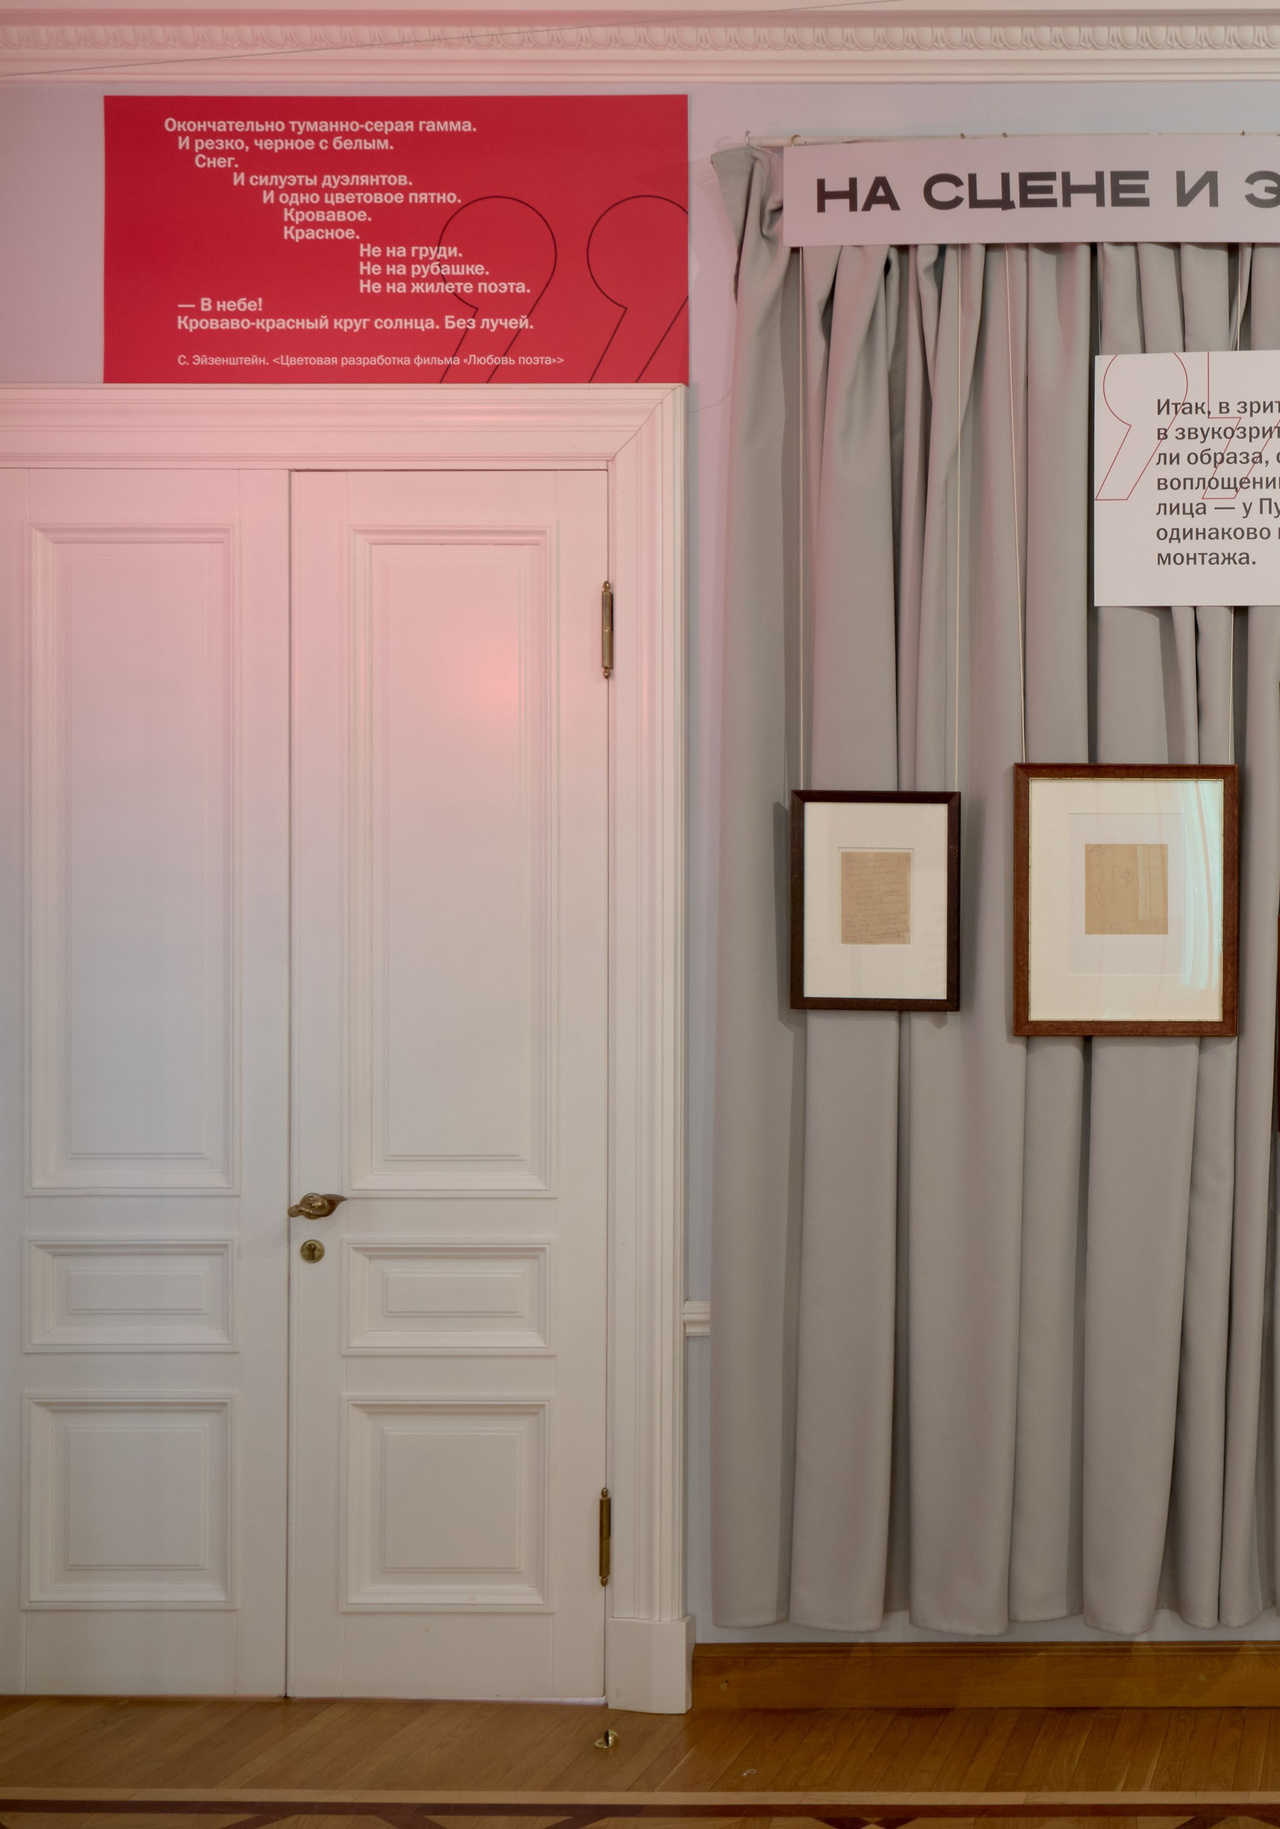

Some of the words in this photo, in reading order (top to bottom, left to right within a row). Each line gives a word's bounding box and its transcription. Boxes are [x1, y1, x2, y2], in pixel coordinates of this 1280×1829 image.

[164, 117, 286, 133] Окончательно
[288, 120, 415, 136] туманно-серая
[418, 120, 477, 133] гамма.
[177, 135, 190, 150] И
[194, 138, 250, 153] резко,
[253, 138, 316, 153] черное
[318, 138, 329, 151] с
[332, 135, 394, 151] белым.
[194, 153, 239, 169] Снег.
[233, 171, 245, 187] И
[248, 174, 318, 190] силуэты
[321, 174, 413, 189] дуэлянтов.
[262, 189, 275, 204] И
[278, 192, 320, 207] одно
[324, 192, 405, 206] цветовое
[408, 192, 462, 204] пятно.
[816, 175, 902, 214] НА
[922, 169, 1151, 212] СЦЕНЕ
[1175, 169, 1220, 208] И
[283, 207, 372, 225] Кровавое.
[283, 225, 360, 243] Красное.
[359, 242, 382, 258] Не
[386, 245, 407, 258] на
[411, 245, 463, 261] груди.
[359, 260, 382, 276] Не
[386, 263, 407, 276] на
[411, 261, 490, 279] рубашке.
[359, 278, 382, 294] Не
[386, 281, 407, 294] на
[410, 281, 474, 294] жилете
[477, 281, 531, 294] поэта.
[200, 297, 213, 312] В
[216, 297, 263, 312] небе!
[177, 314, 329, 333] Кроваво-красный
[333, 317, 371, 333] круг
[373, 317, 440, 332] солнца.
[444, 314, 477, 330] Без
[479, 314, 534, 333] лучей.
[177, 354, 190, 366] С.
[192, 354, 269, 366] Эйзенштейн.
[340, 354, 411, 368] разработка
[413, 354, 461, 368] фильма
[1156, 398, 1212, 419] Итак,
[1218, 401, 1231, 415] в
[1156, 427, 1169, 441] в
[1155, 452, 1180, 466] ли
[1186, 447, 1270, 469] образа,
[1155, 501, 1207, 519] лица
[1241, 501, 1253, 519] у
[1155, 526, 1272, 544] одинаково
[1157, 551, 1257, 566] монтажа.
